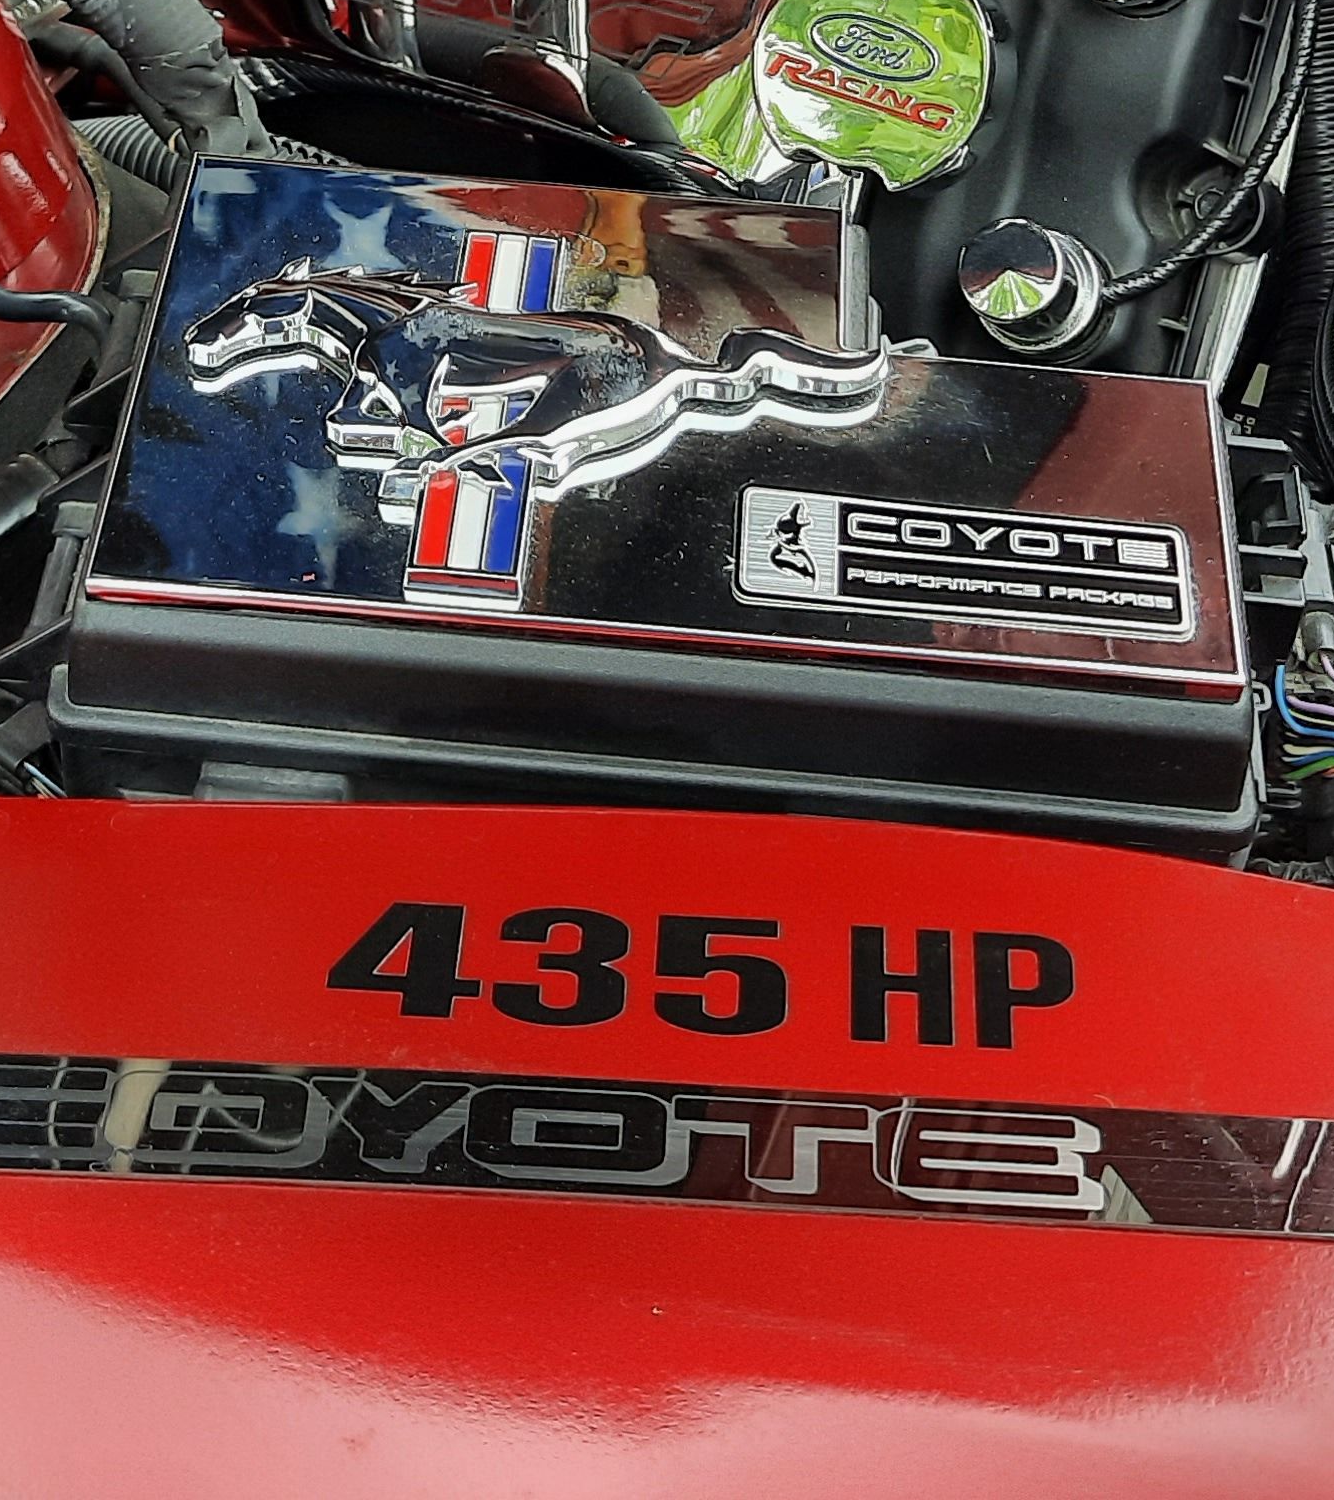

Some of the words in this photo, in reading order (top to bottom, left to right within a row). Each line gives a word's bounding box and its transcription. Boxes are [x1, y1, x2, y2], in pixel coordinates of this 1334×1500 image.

[832, 21, 915, 72] Ford
[765, 51, 962, 132] RACING
[846, 512, 1170, 569] COYOTE
[846, 568, 1042, 600] PERFORMANCE
[1049, 585, 1174, 610] PACKAGE
[324, 900, 790, 1037] 435
[849, 924, 1075, 1051] HP
